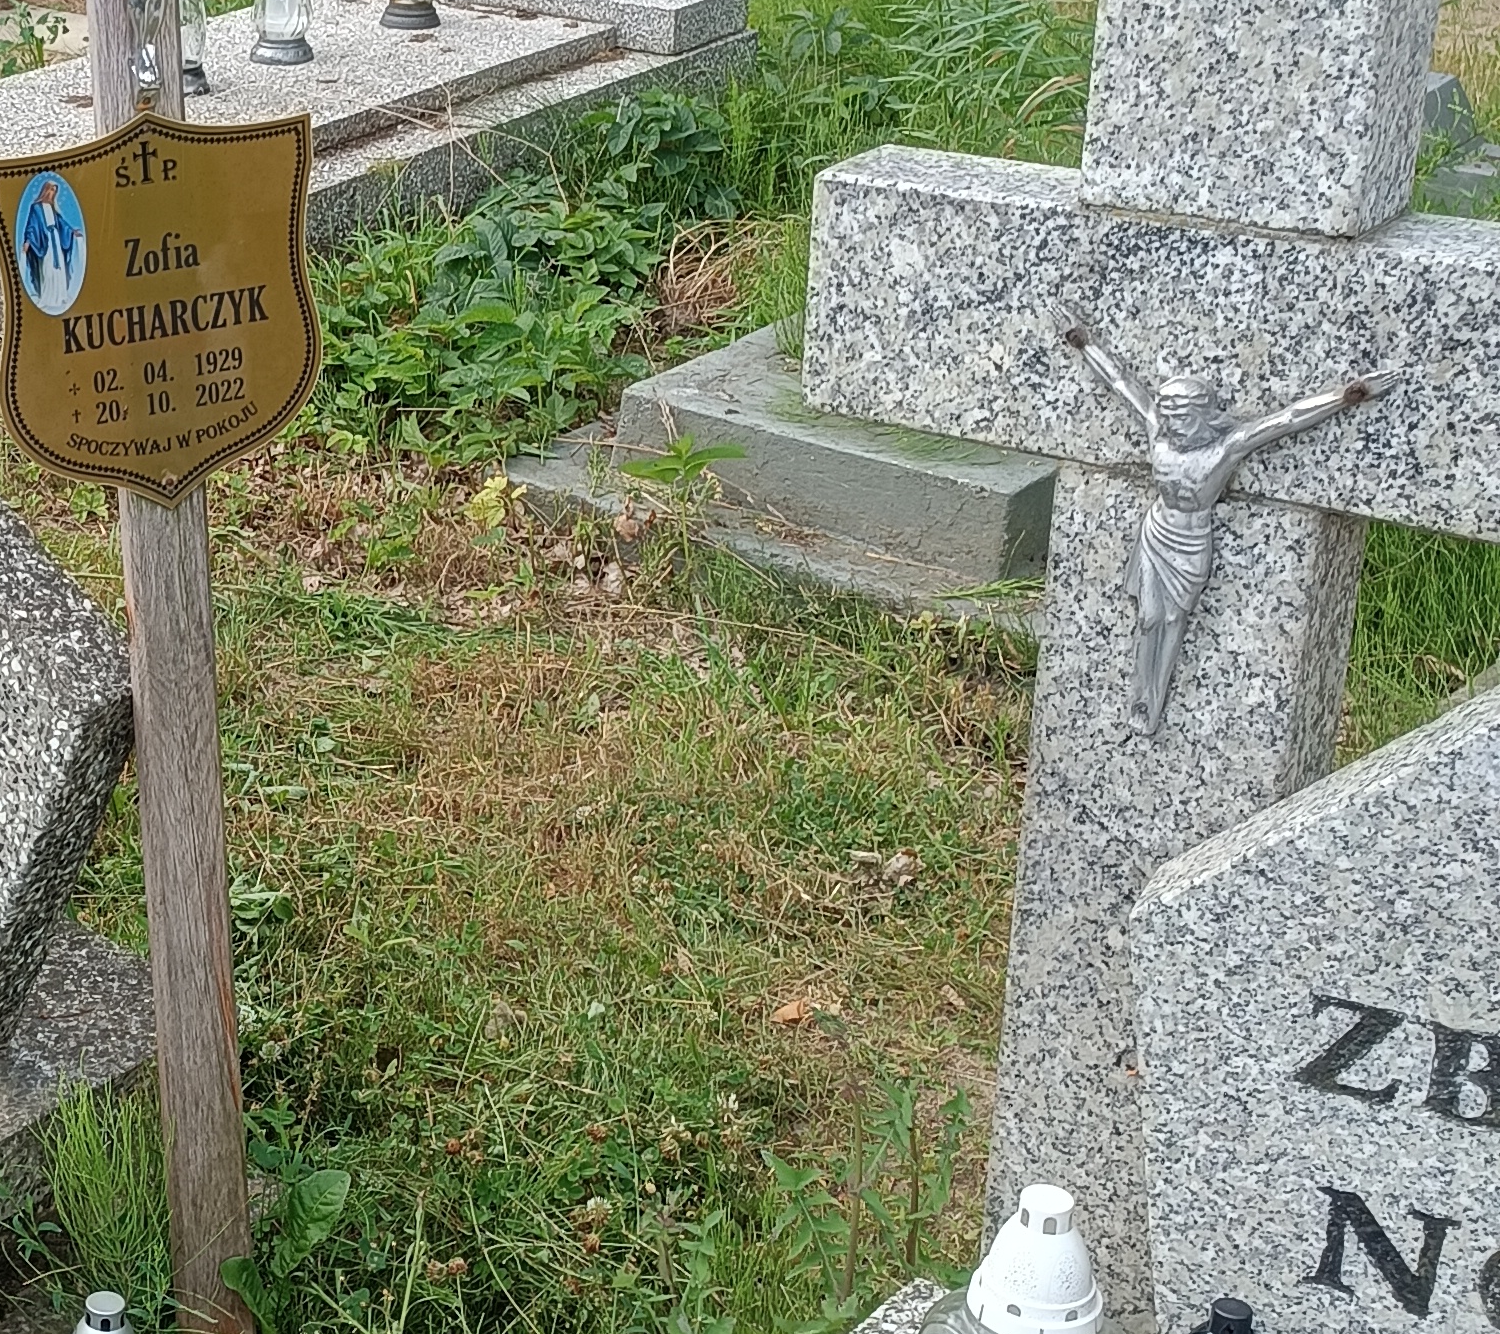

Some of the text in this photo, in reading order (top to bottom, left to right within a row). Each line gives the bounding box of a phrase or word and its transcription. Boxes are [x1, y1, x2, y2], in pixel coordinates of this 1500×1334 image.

[115, 157, 178, 188] Ś. P.
[124, 232, 200, 278] Zofia
[62, 284, 269, 355] KUCHARCZYK
[93, 346, 244, 396] 02. 04. 1929
[146, 390, 176, 417] 10.
[195, 377, 246, 409] 2022
[66, 400, 259, 457] SPOCZYWAJ W POKOJU
[1302, 1186, 1500, 1331] N
